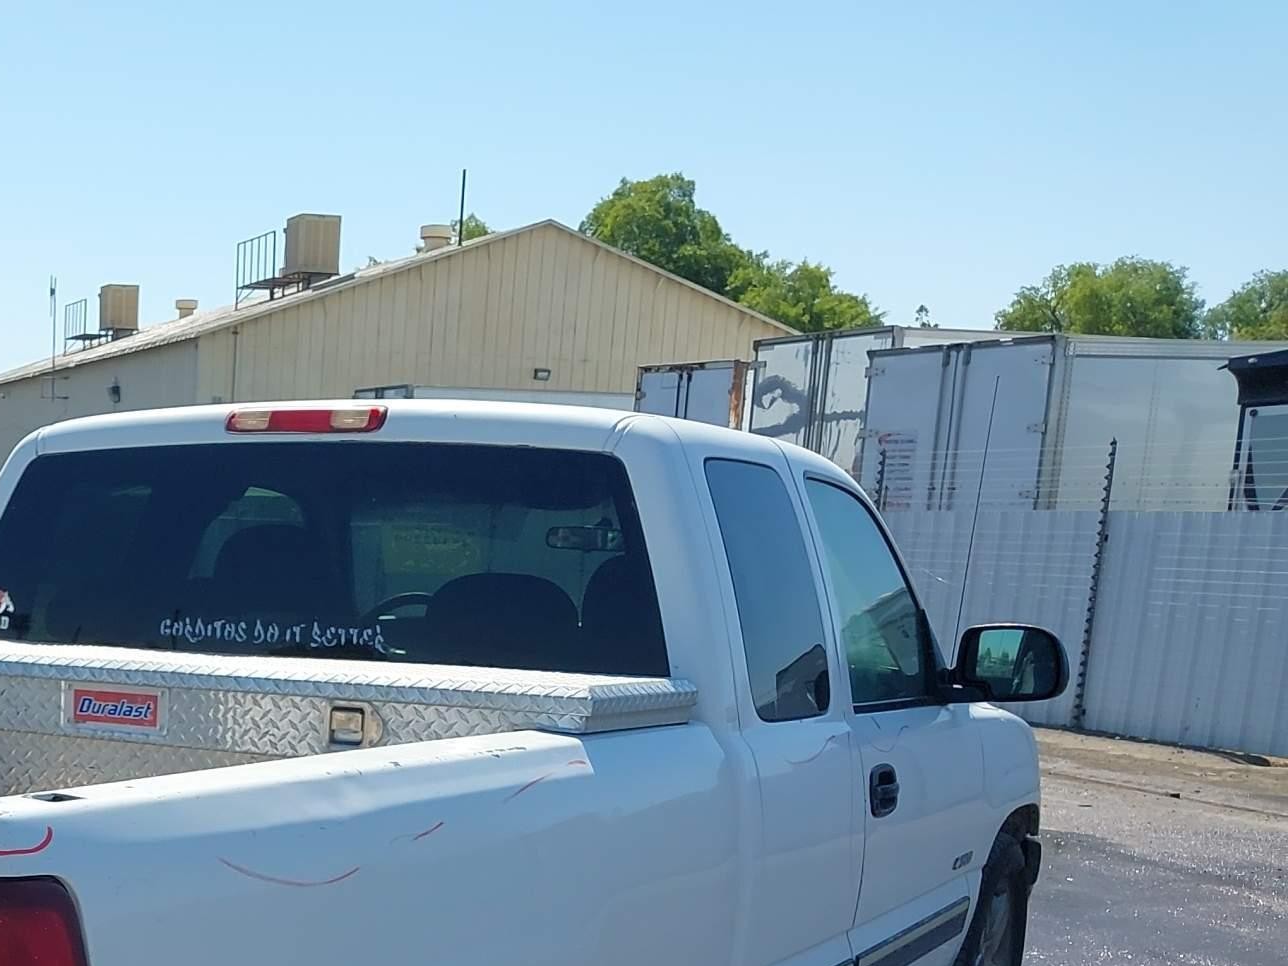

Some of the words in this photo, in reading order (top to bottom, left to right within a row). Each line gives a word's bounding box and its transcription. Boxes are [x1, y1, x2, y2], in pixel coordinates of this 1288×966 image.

[252, 619, 280, 644] DO
[285, 623, 306, 642] IT
[78, 696, 153, 720] Duralast
